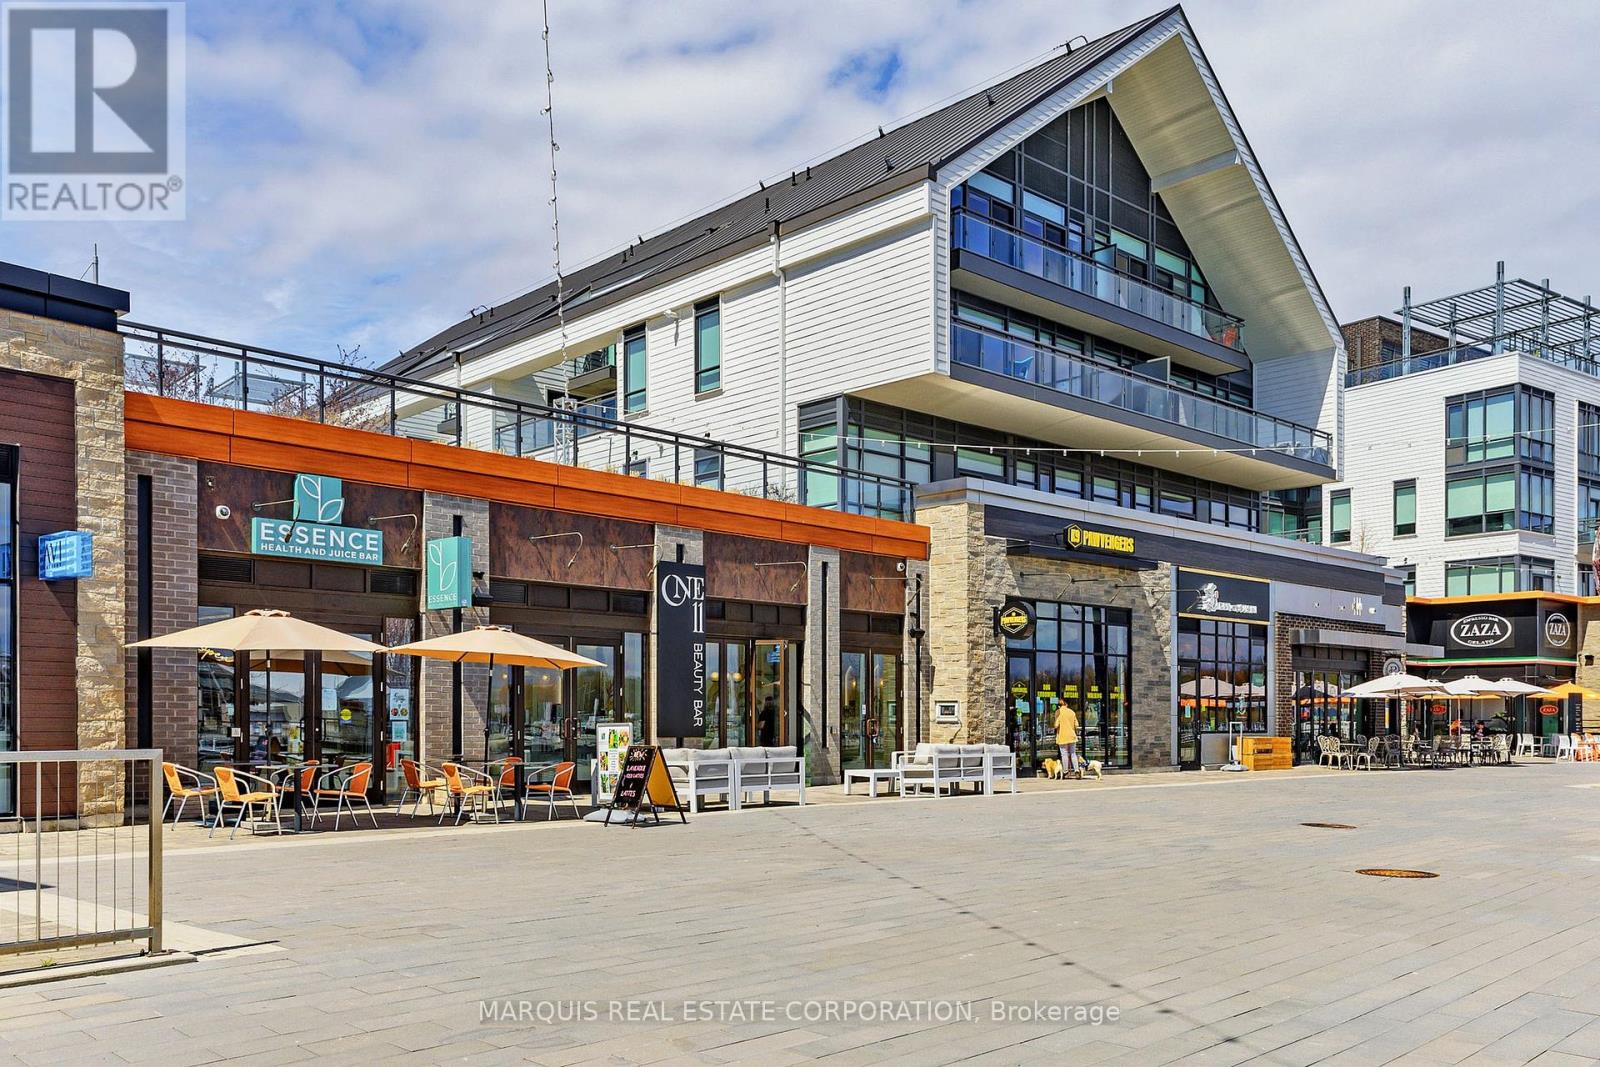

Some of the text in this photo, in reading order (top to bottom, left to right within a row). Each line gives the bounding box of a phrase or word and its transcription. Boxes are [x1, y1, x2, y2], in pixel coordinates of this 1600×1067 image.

[260, 522, 379, 552] ESSENCE
[1082, 530, 1135, 553] PAWVENGERS
[260, 543, 379, 561] HEALTH AND JUICE BAR
[429, 592, 457, 603] ESSENCE
[661, 574, 705, 607] ONE
[1460, 622, 1501, 637] ZAZA
[1549, 622, 1567, 636] ZAZA
[693, 643, 704, 727] BEAUTY BAR
